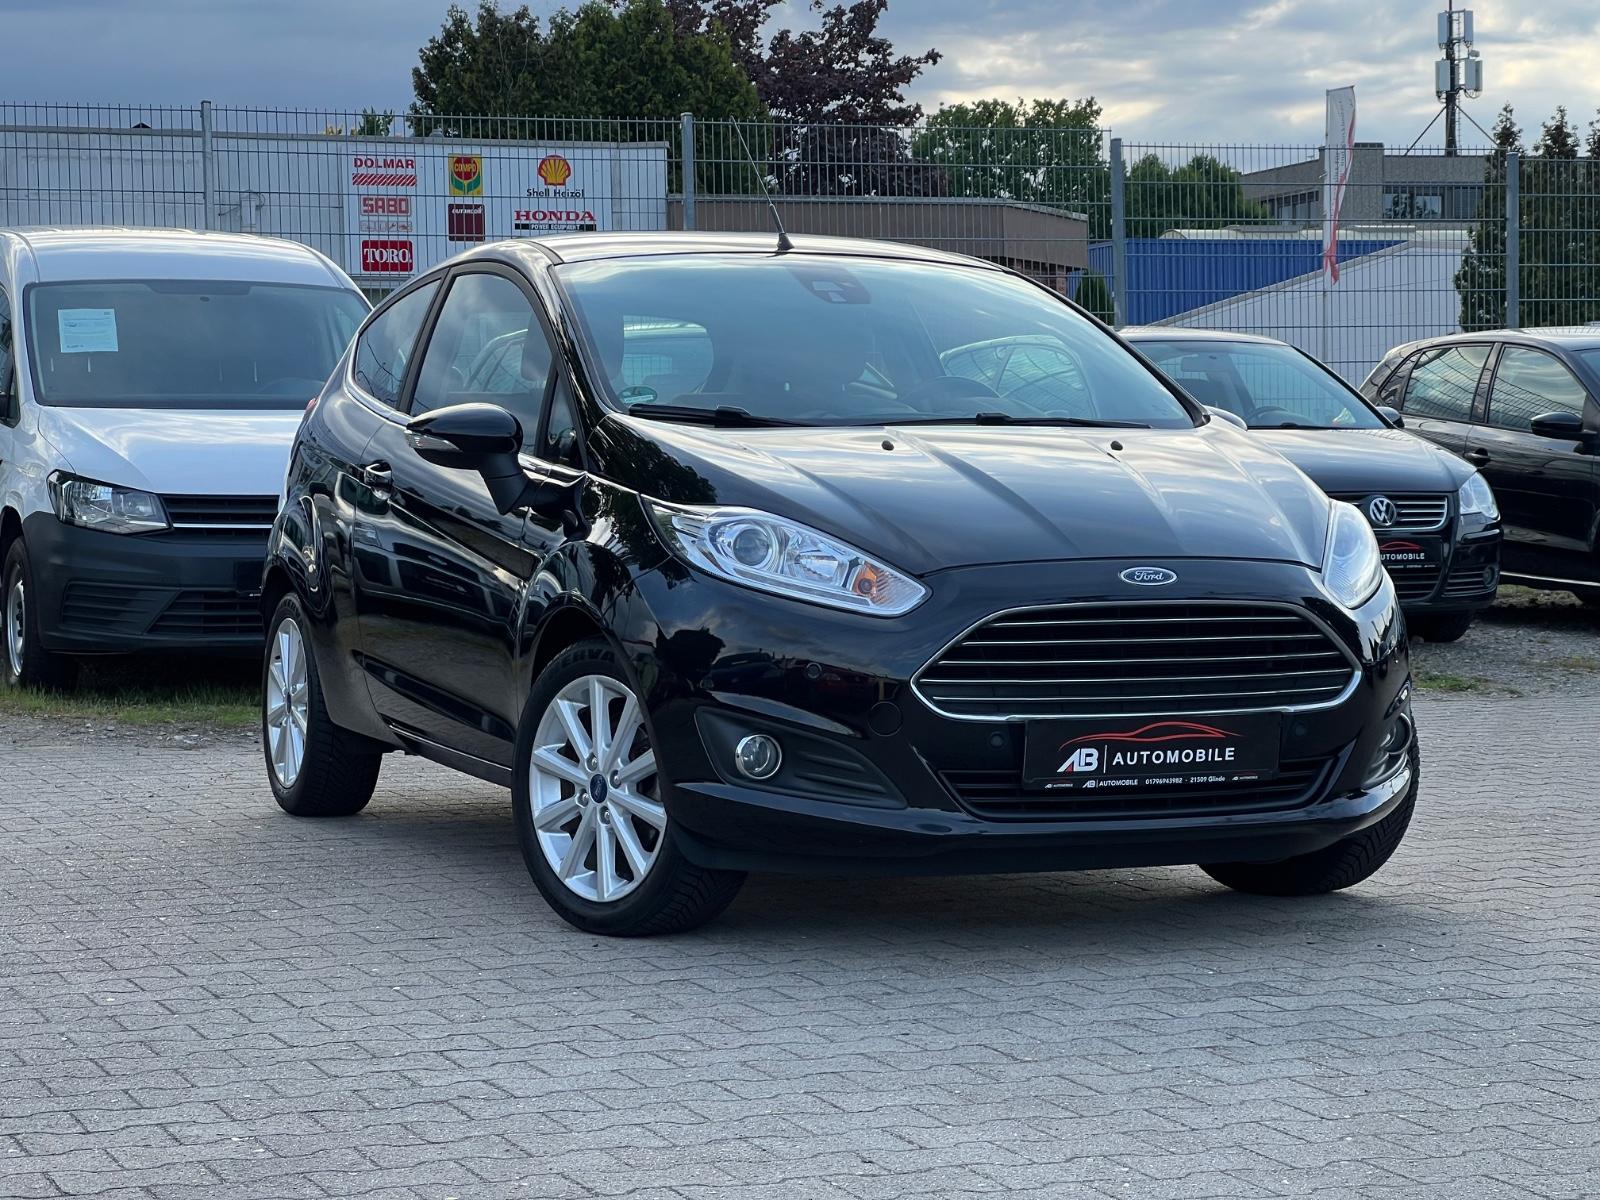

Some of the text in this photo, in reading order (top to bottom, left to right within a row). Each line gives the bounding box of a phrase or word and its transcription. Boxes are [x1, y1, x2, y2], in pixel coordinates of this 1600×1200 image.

[353, 157, 415, 169] DOLMAR
[526, 188, 550, 197] Shell
[362, 197, 410, 214] SABO
[514, 210, 597, 222] HONDA
[1380, 553, 1425, 561] UTOMOBILE
[1134, 570, 1165, 581] Ford
[1112, 747, 1235, 766] AUTOMOBILE
[1099, 778, 1139, 787] AUTOMOBILE
